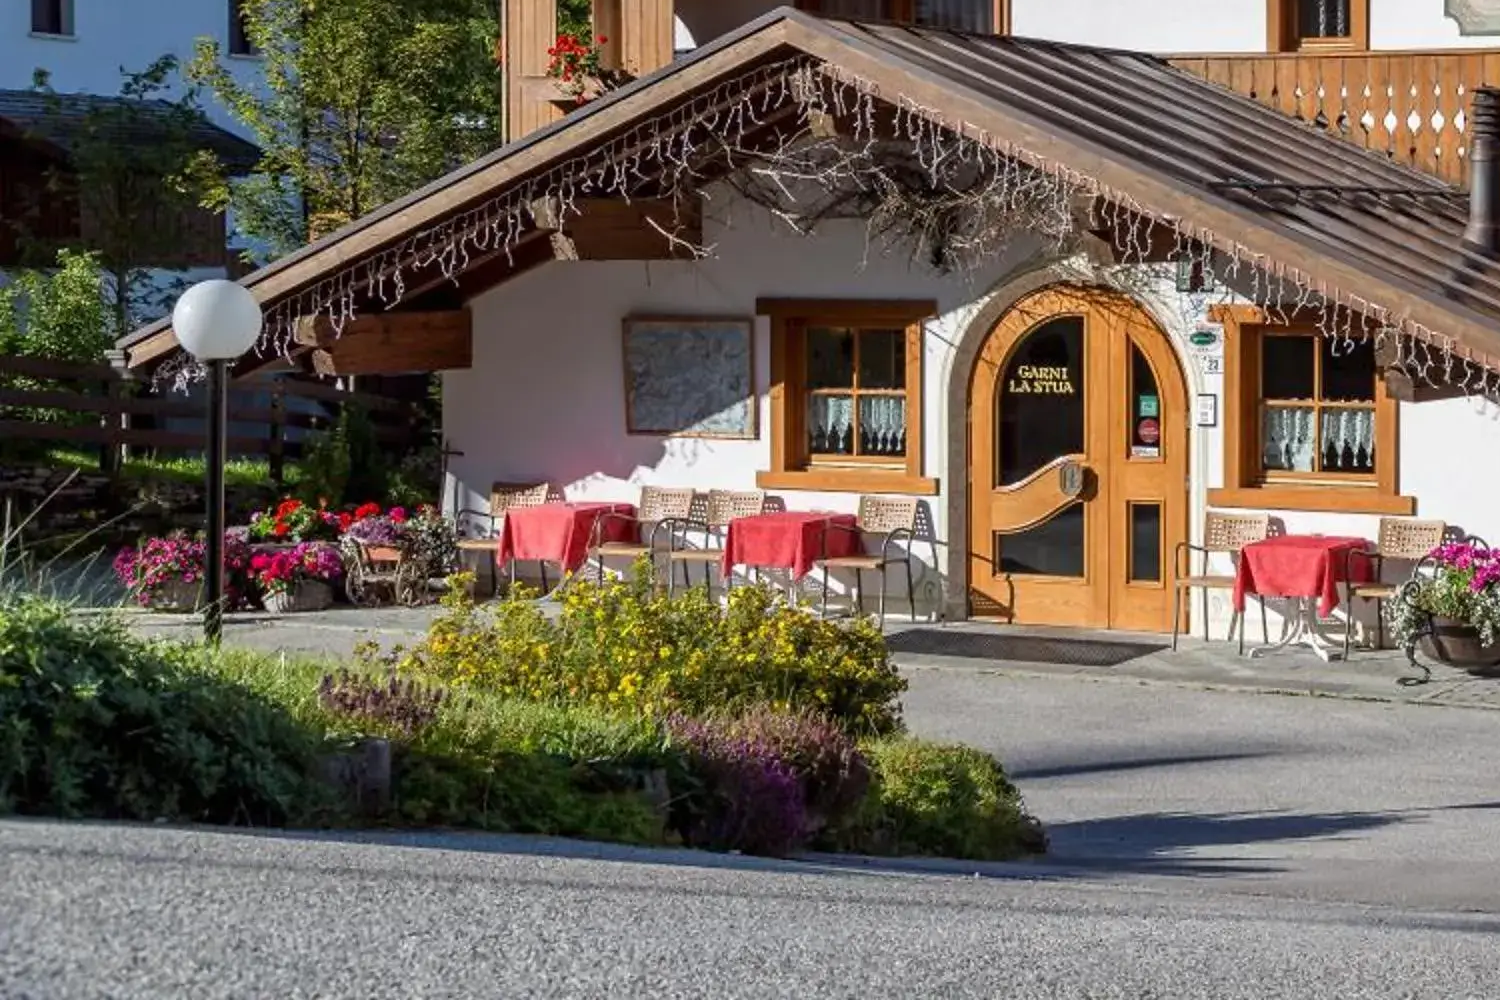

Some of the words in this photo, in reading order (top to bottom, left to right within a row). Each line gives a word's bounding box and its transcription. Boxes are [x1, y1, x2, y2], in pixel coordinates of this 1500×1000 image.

[1018, 365, 1068, 379] GARNI
[1009, 380, 1032, 393] LA
[1033, 381, 1074, 394] STUA
